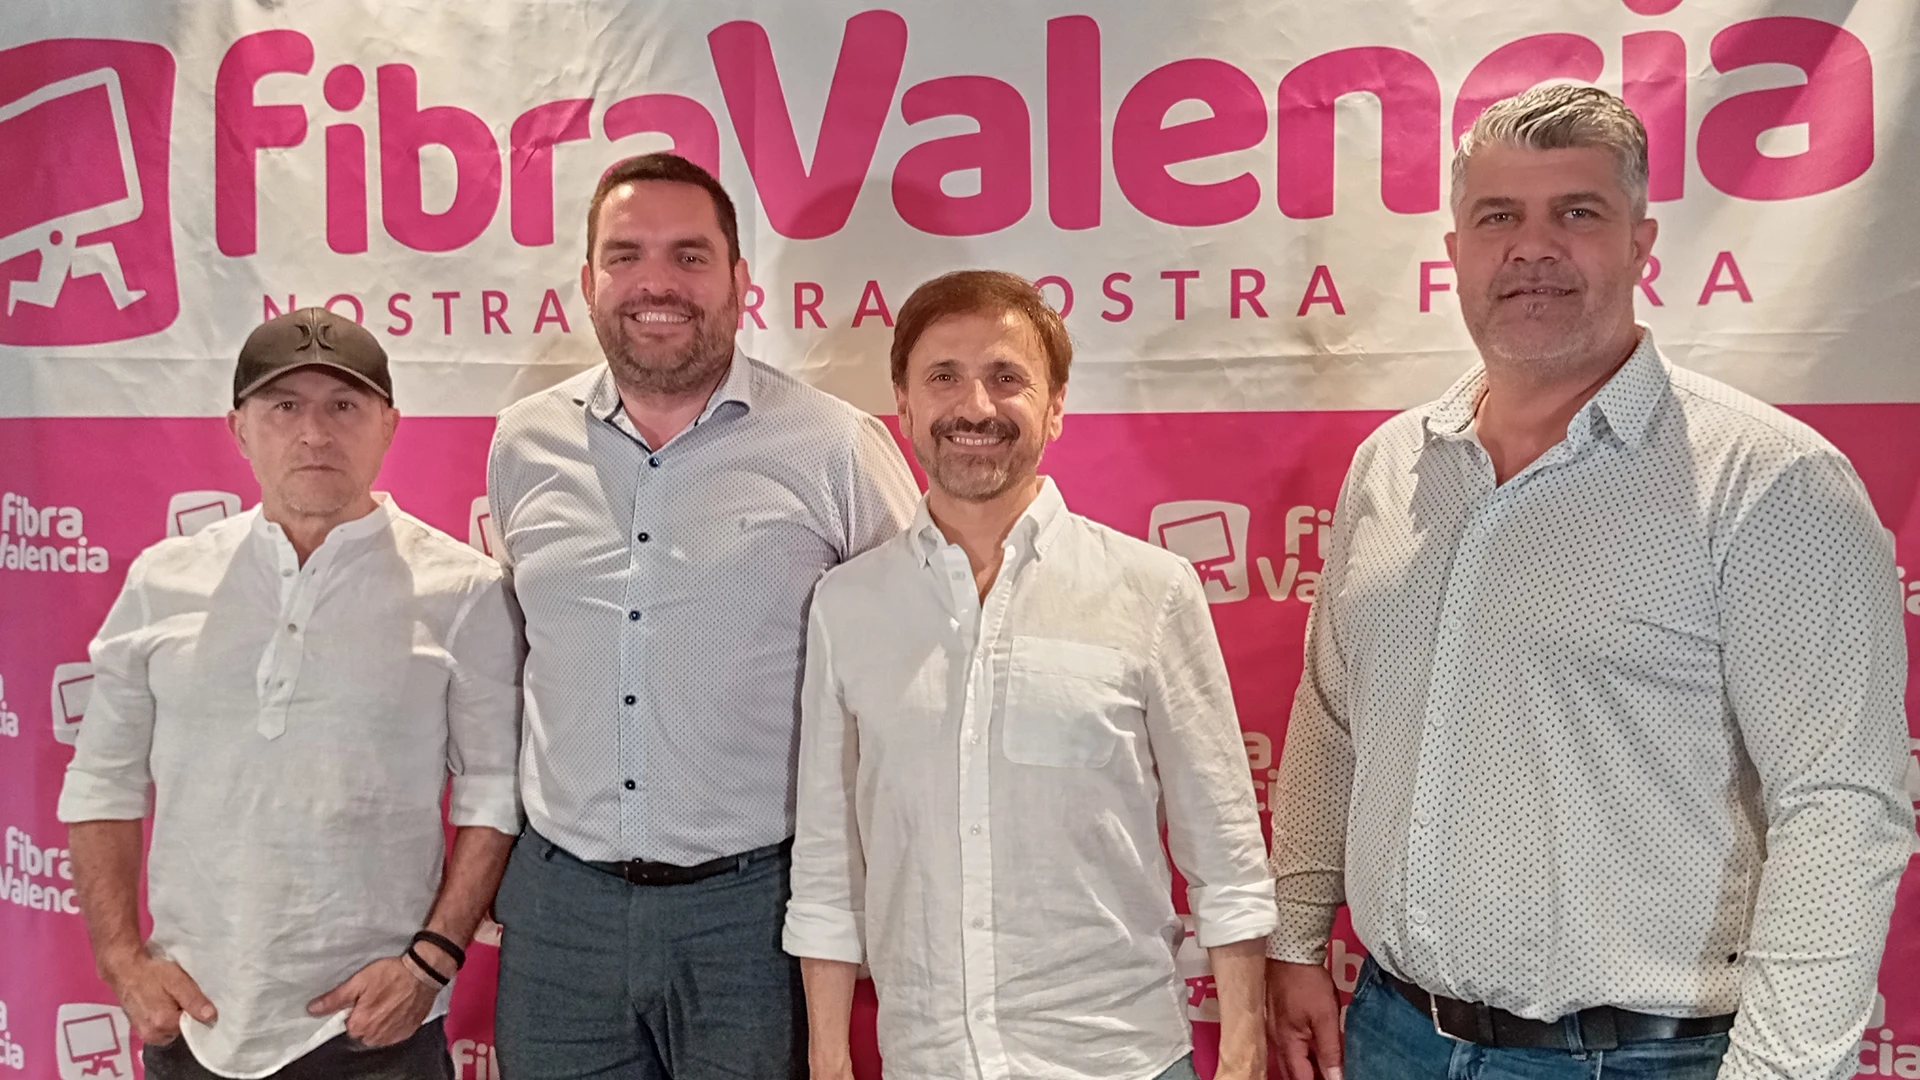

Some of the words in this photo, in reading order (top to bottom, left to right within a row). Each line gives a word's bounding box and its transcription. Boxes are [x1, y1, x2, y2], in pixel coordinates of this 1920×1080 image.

[737, 279, 895, 331] RRA
[1034, 264, 1346, 323] OSTRA
[2, 491, 84, 539] fibra
[0, 864, 80, 914] Valenc
